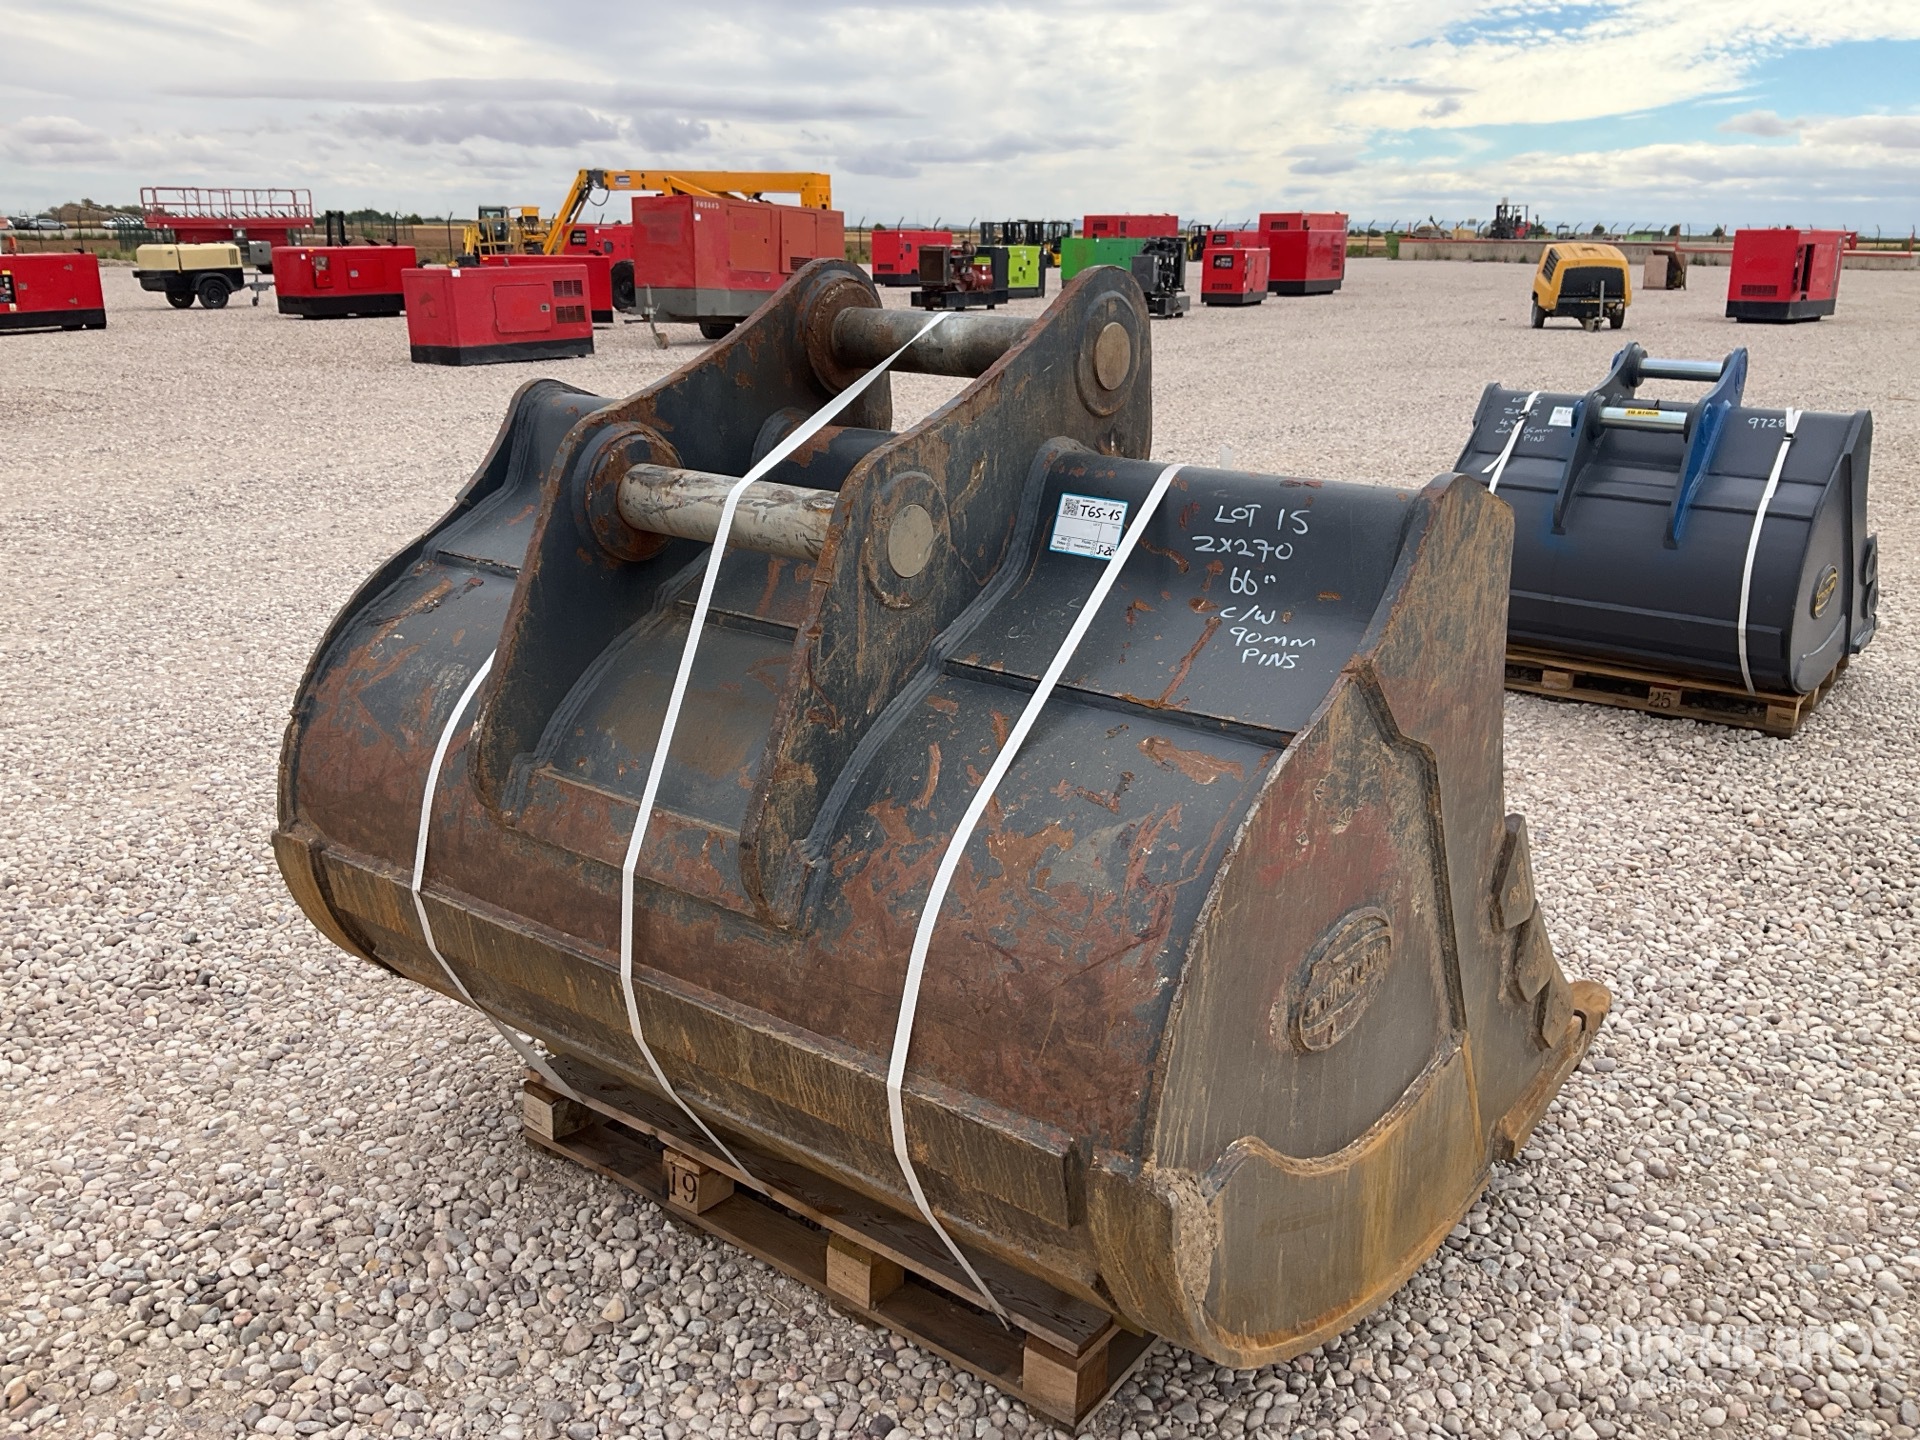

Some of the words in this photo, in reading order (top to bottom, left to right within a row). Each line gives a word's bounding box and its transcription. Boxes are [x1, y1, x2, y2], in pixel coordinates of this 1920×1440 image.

[1213, 503, 1262, 528] LOT
[1277, 508, 1312, 535] 15
[1241, 647, 1300, 670] PINS
[1648, 691, 1671, 709] 25
[669, 1164, 698, 1204] 19
